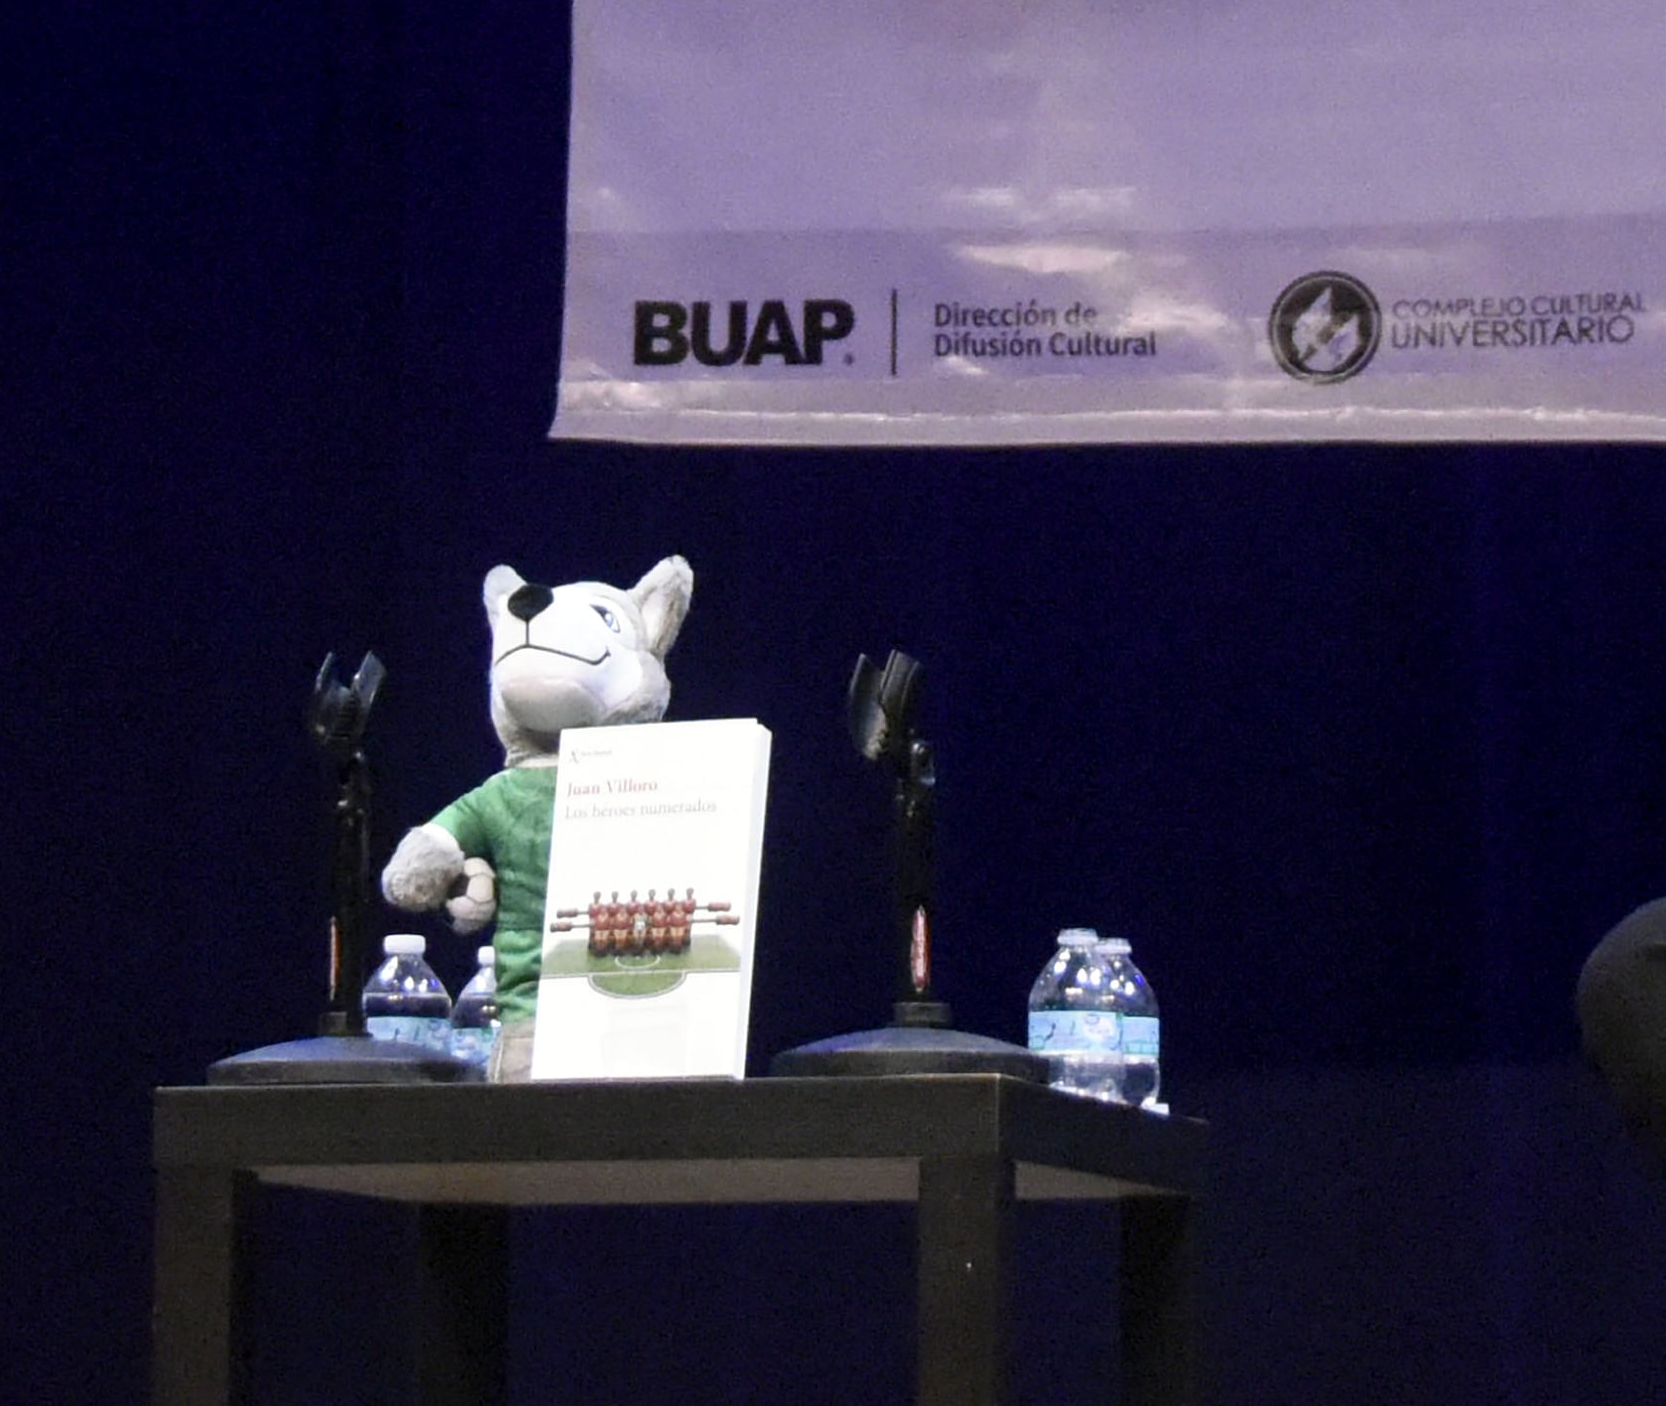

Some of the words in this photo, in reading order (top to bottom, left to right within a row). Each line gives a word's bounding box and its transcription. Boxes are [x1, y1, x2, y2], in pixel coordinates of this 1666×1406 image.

[934, 299, 1057, 328] Dirección
[1065, 302, 1098, 326] de
[1391, 295, 1526, 320] COMPLEJO
[1532, 292, 1646, 315] CULTURAL
[934, 330, 1043, 358] Difusión
[1049, 329, 1158, 358] Cultural
[1391, 314, 1635, 350] UNIVERSITARIO
[566, 780, 601, 798] Juan
[606, 777, 659, 794] Villoro
[564, 804, 588, 820] Los
[640, 797, 718, 816] numerados
